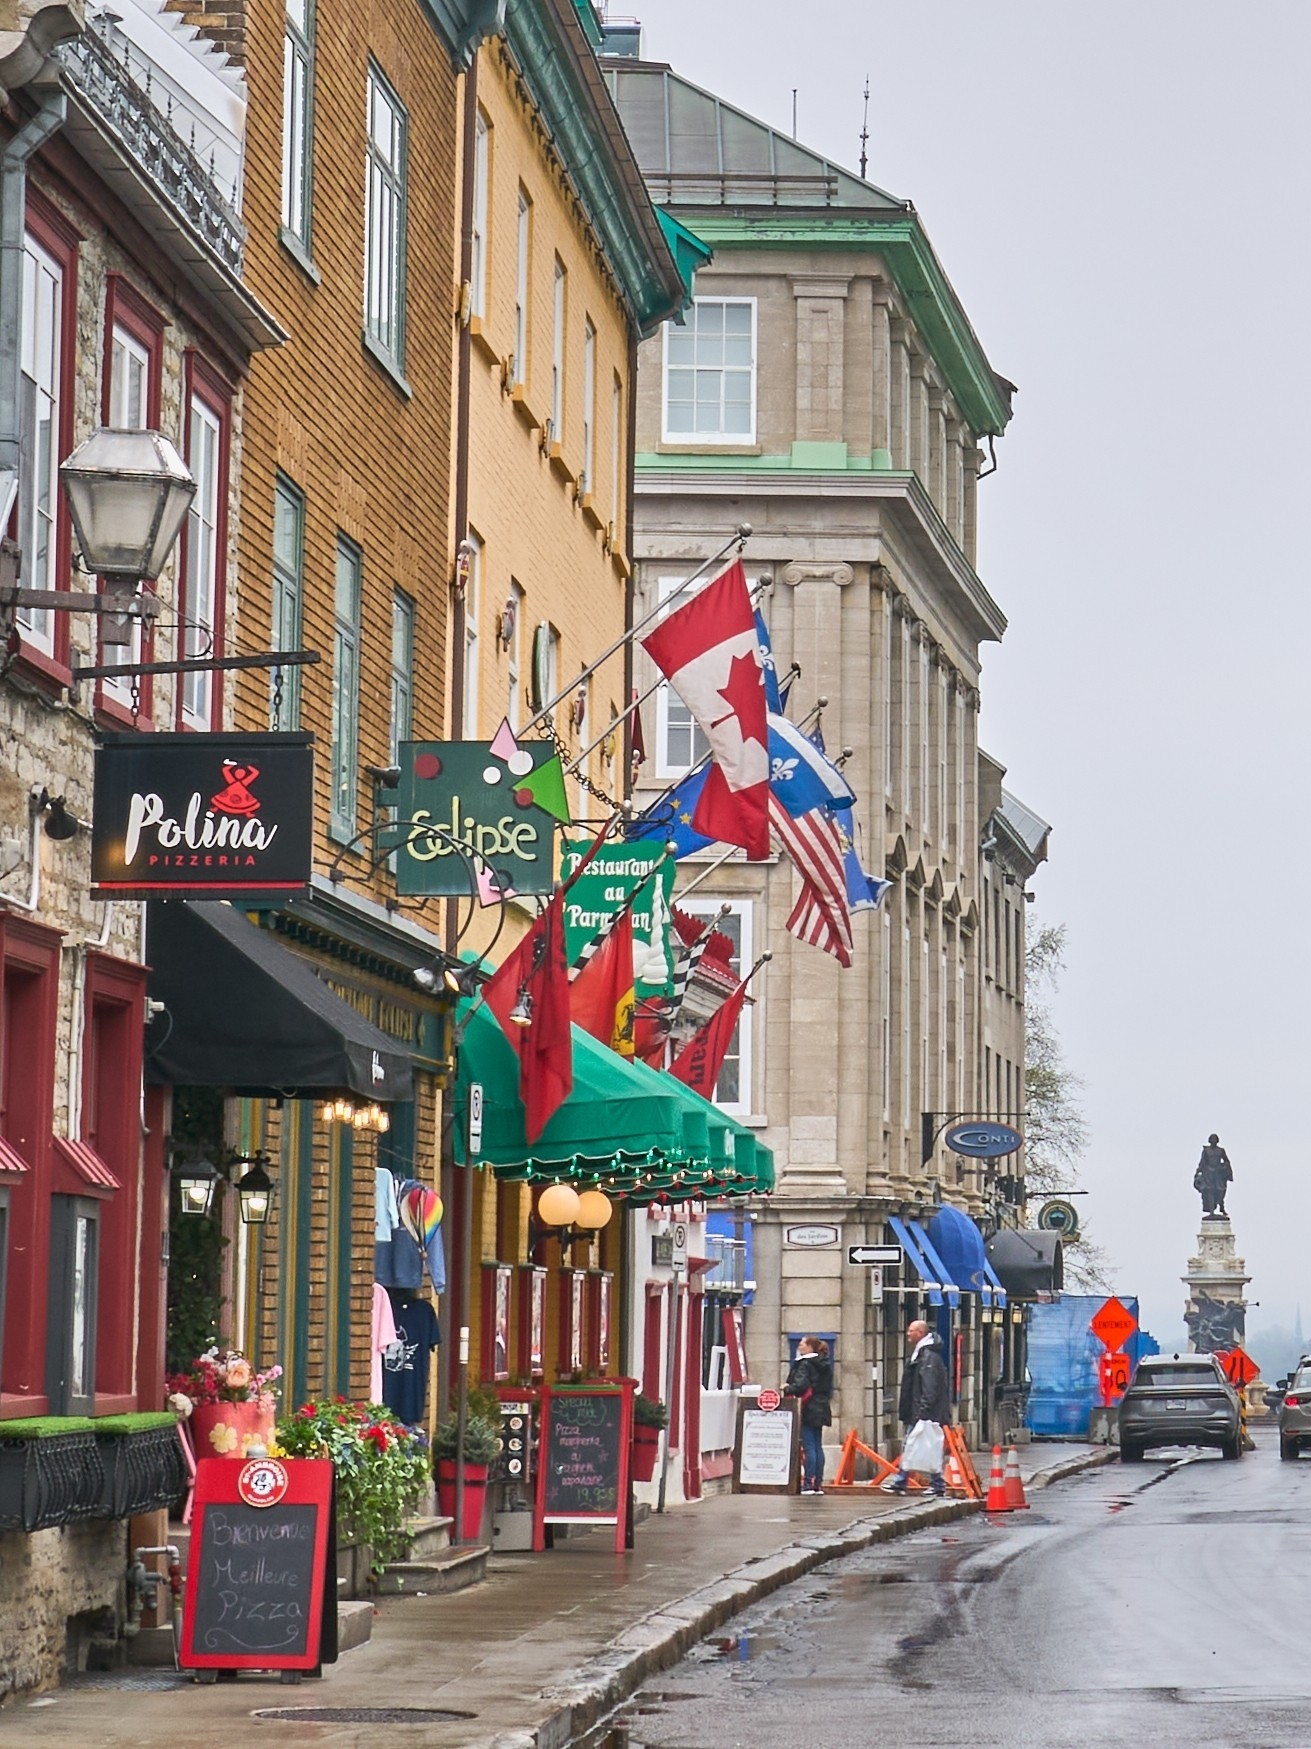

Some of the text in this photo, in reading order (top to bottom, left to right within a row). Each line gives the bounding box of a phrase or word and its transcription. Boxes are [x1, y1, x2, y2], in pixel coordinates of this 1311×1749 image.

[125, 792, 278, 866] Polina
[149, 855, 256, 866] PIZZERIA
[604, 886, 625, 901] au
[952, 1130, 1015, 1148] CONTI
[210, 1512, 310, 1545] Bienvenue
[212, 1557, 299, 1588] Meilleure
[217, 1589, 303, 1622] Pizza
